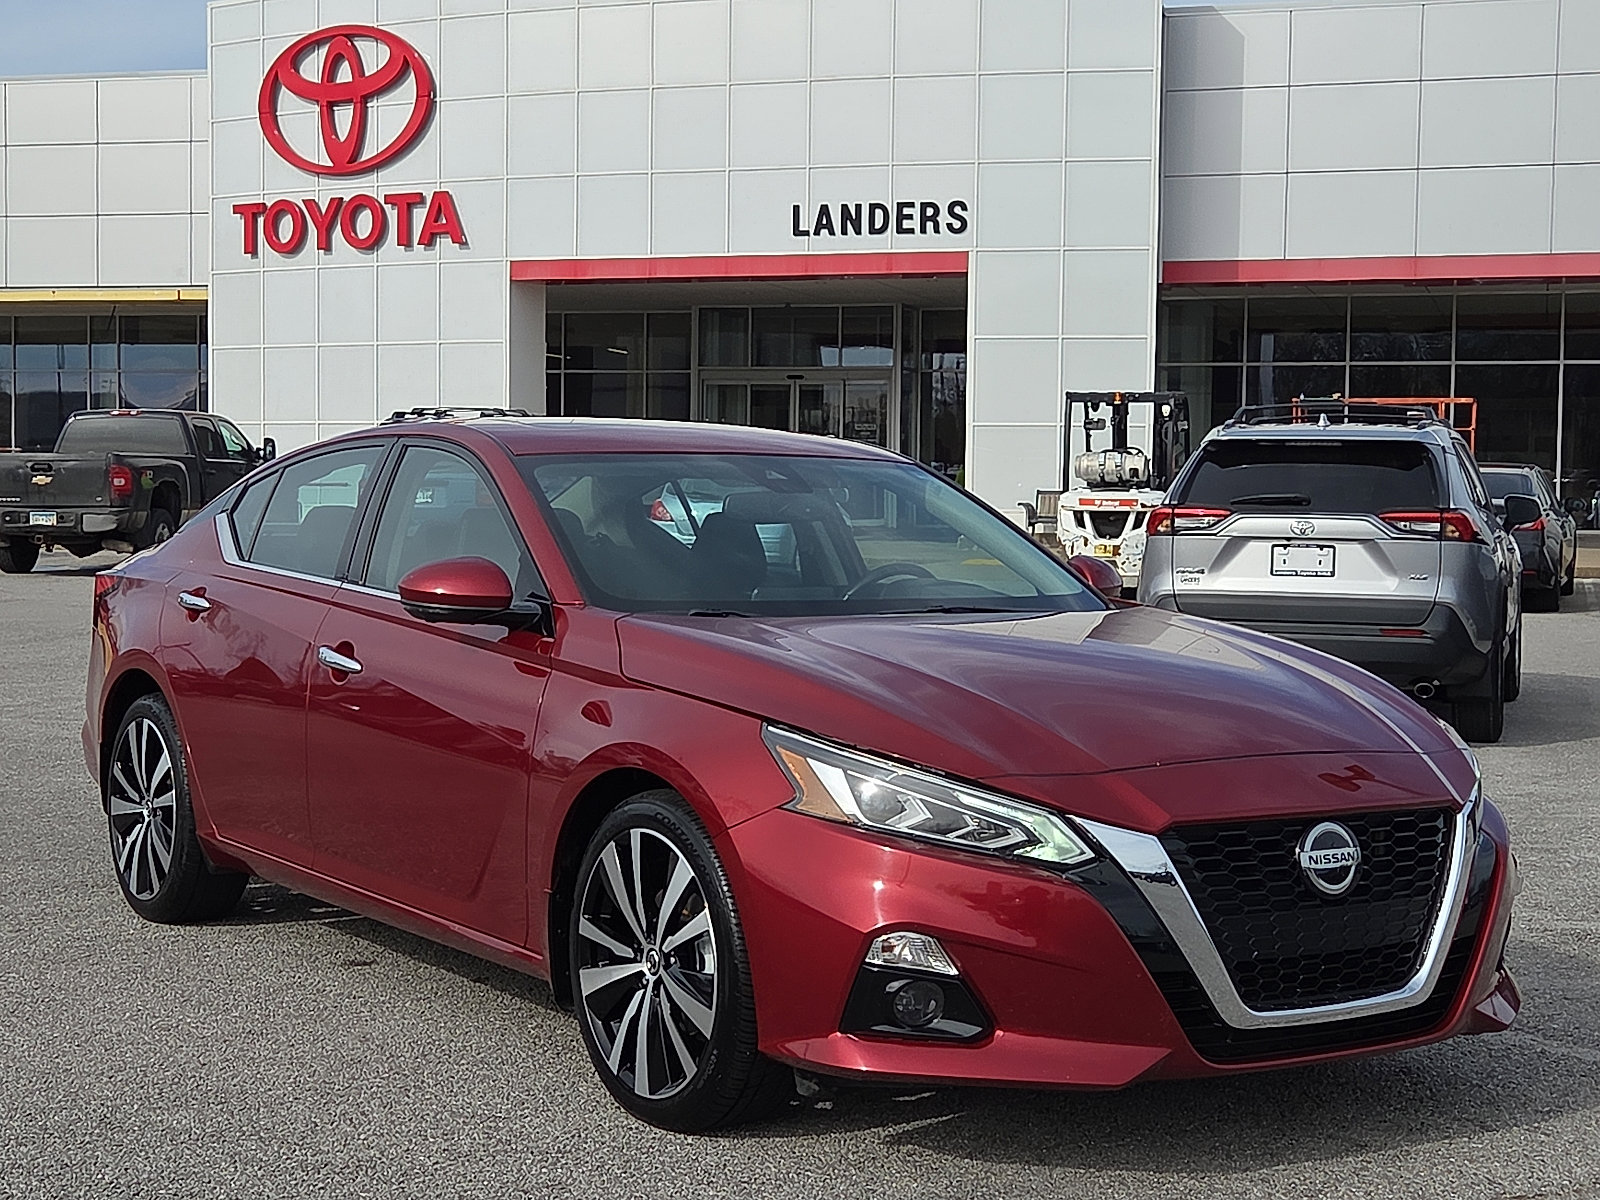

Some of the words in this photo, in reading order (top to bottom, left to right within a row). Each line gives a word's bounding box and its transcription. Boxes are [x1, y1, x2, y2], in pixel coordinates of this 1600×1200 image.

[232, 190, 466, 255] TOYOTA
[792, 200, 968, 237] LANDERS
[1308, 851, 1355, 865] NISSAN
